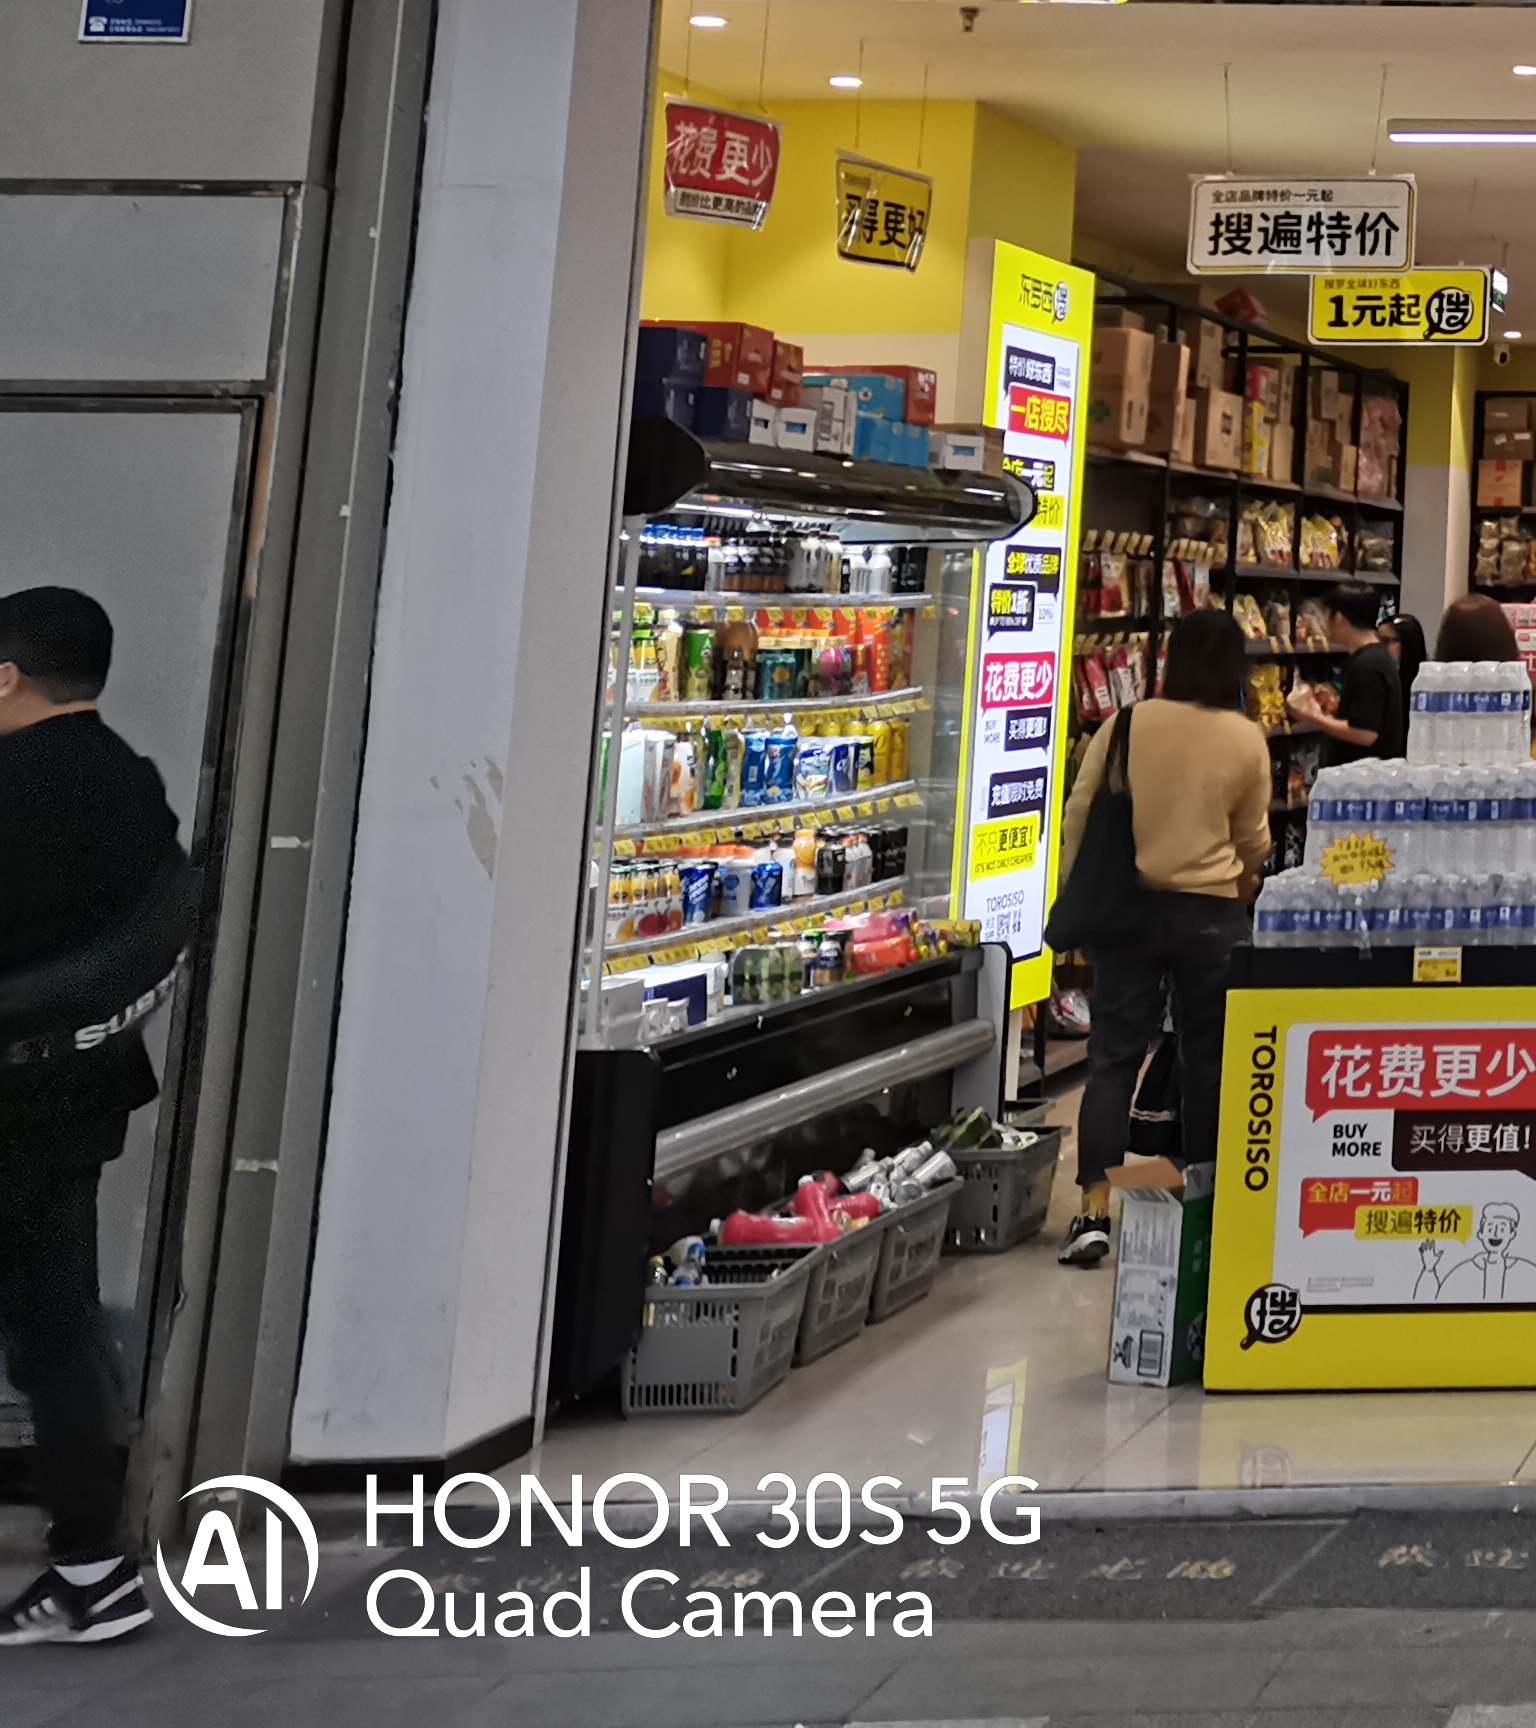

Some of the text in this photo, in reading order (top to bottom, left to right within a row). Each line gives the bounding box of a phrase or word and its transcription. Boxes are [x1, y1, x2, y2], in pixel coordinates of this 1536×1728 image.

[672, 121, 772, 186] 花费更少
[1208, 211, 1399, 257] 搜遍特价
[1328, 294, 1421, 327] 1元起
[985, 660, 1052, 702] 花费更少
[1321, 1043, 1536, 1098] 花费更少
[1245, 1025, 1276, 1191] TOROSISO
[1332, 1142, 1381, 1157] MORE
[1333, 1124, 1368, 1139] BUY
[1308, 1181, 1413, 1203] 全店一元起
[1365, 1210, 1461, 1234] 搜遍特价
